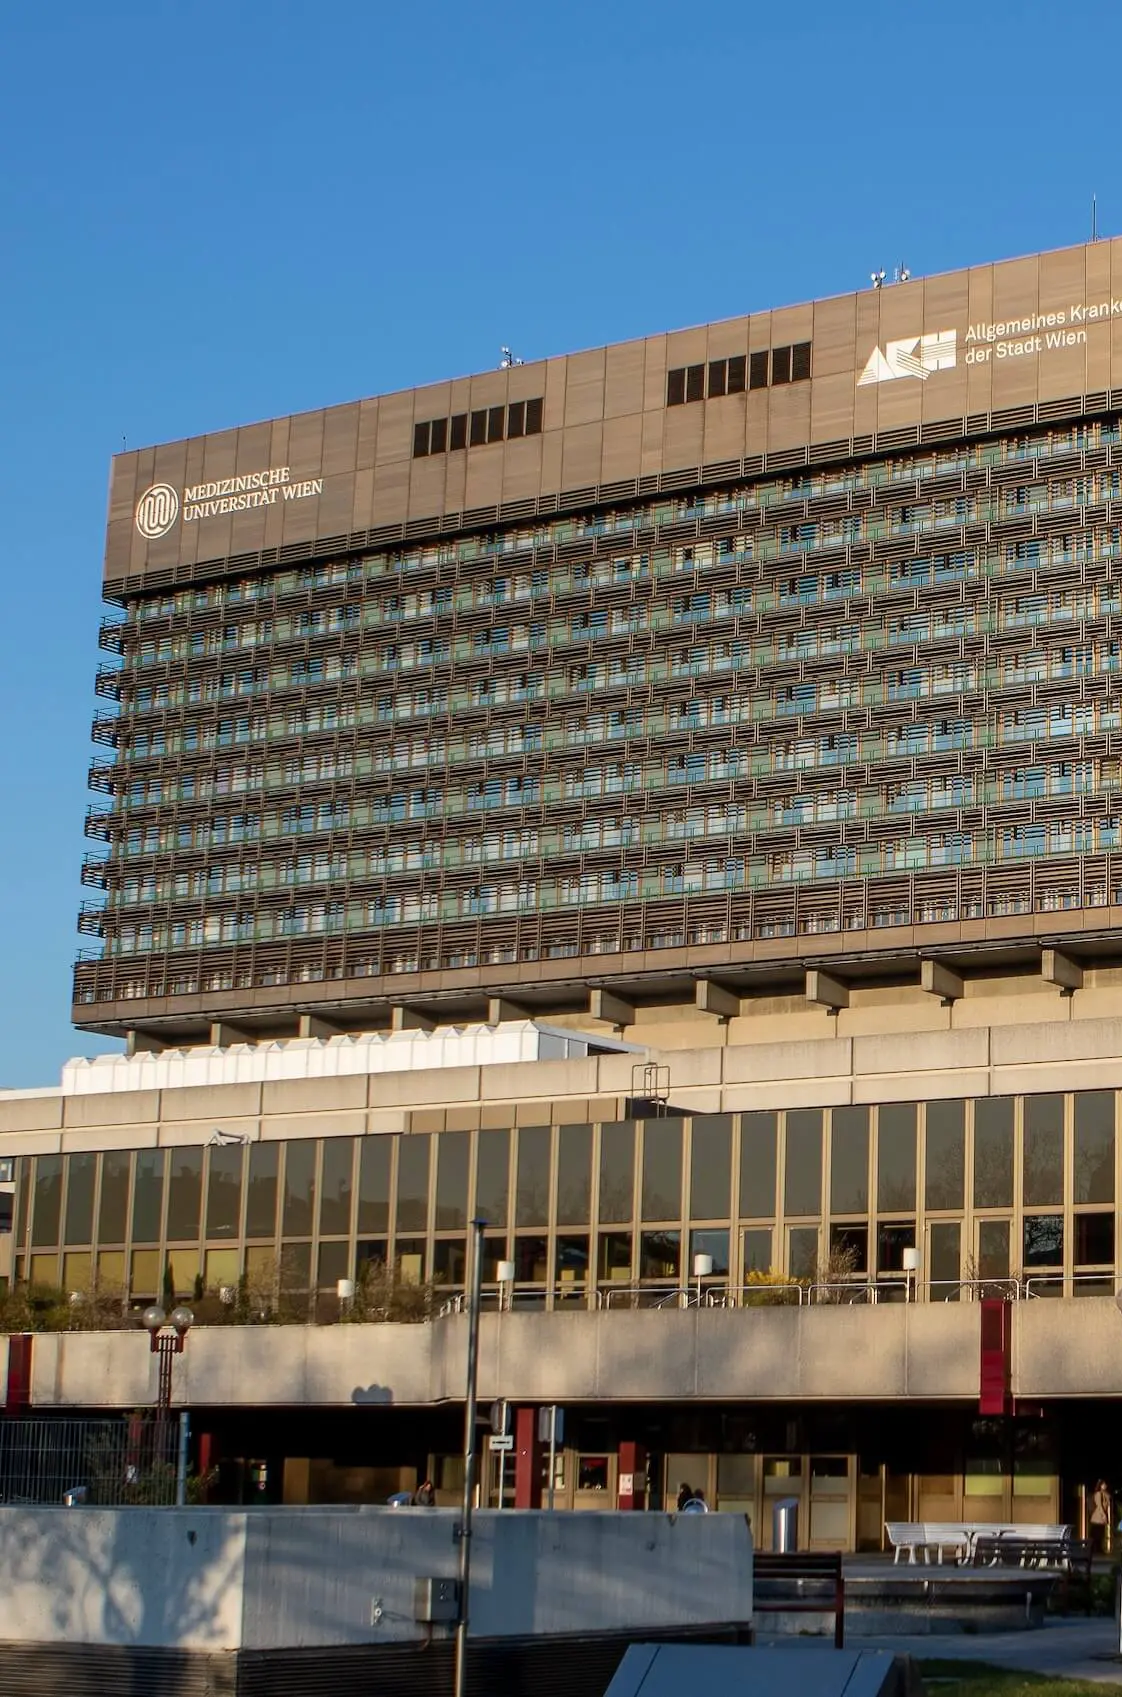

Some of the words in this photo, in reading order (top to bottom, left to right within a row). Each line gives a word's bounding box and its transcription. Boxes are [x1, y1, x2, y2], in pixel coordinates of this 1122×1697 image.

[966, 312, 1066, 342] Allgemeines
[966, 345, 992, 365] der
[997, 336, 1043, 358] Stadt
[1047, 329, 1087, 349] Wien
[183, 486, 279, 521] UNIVERSITÄT
[283, 479, 323, 500] WIEN
[184, 467, 290, 503] MEDIZINISCHE
